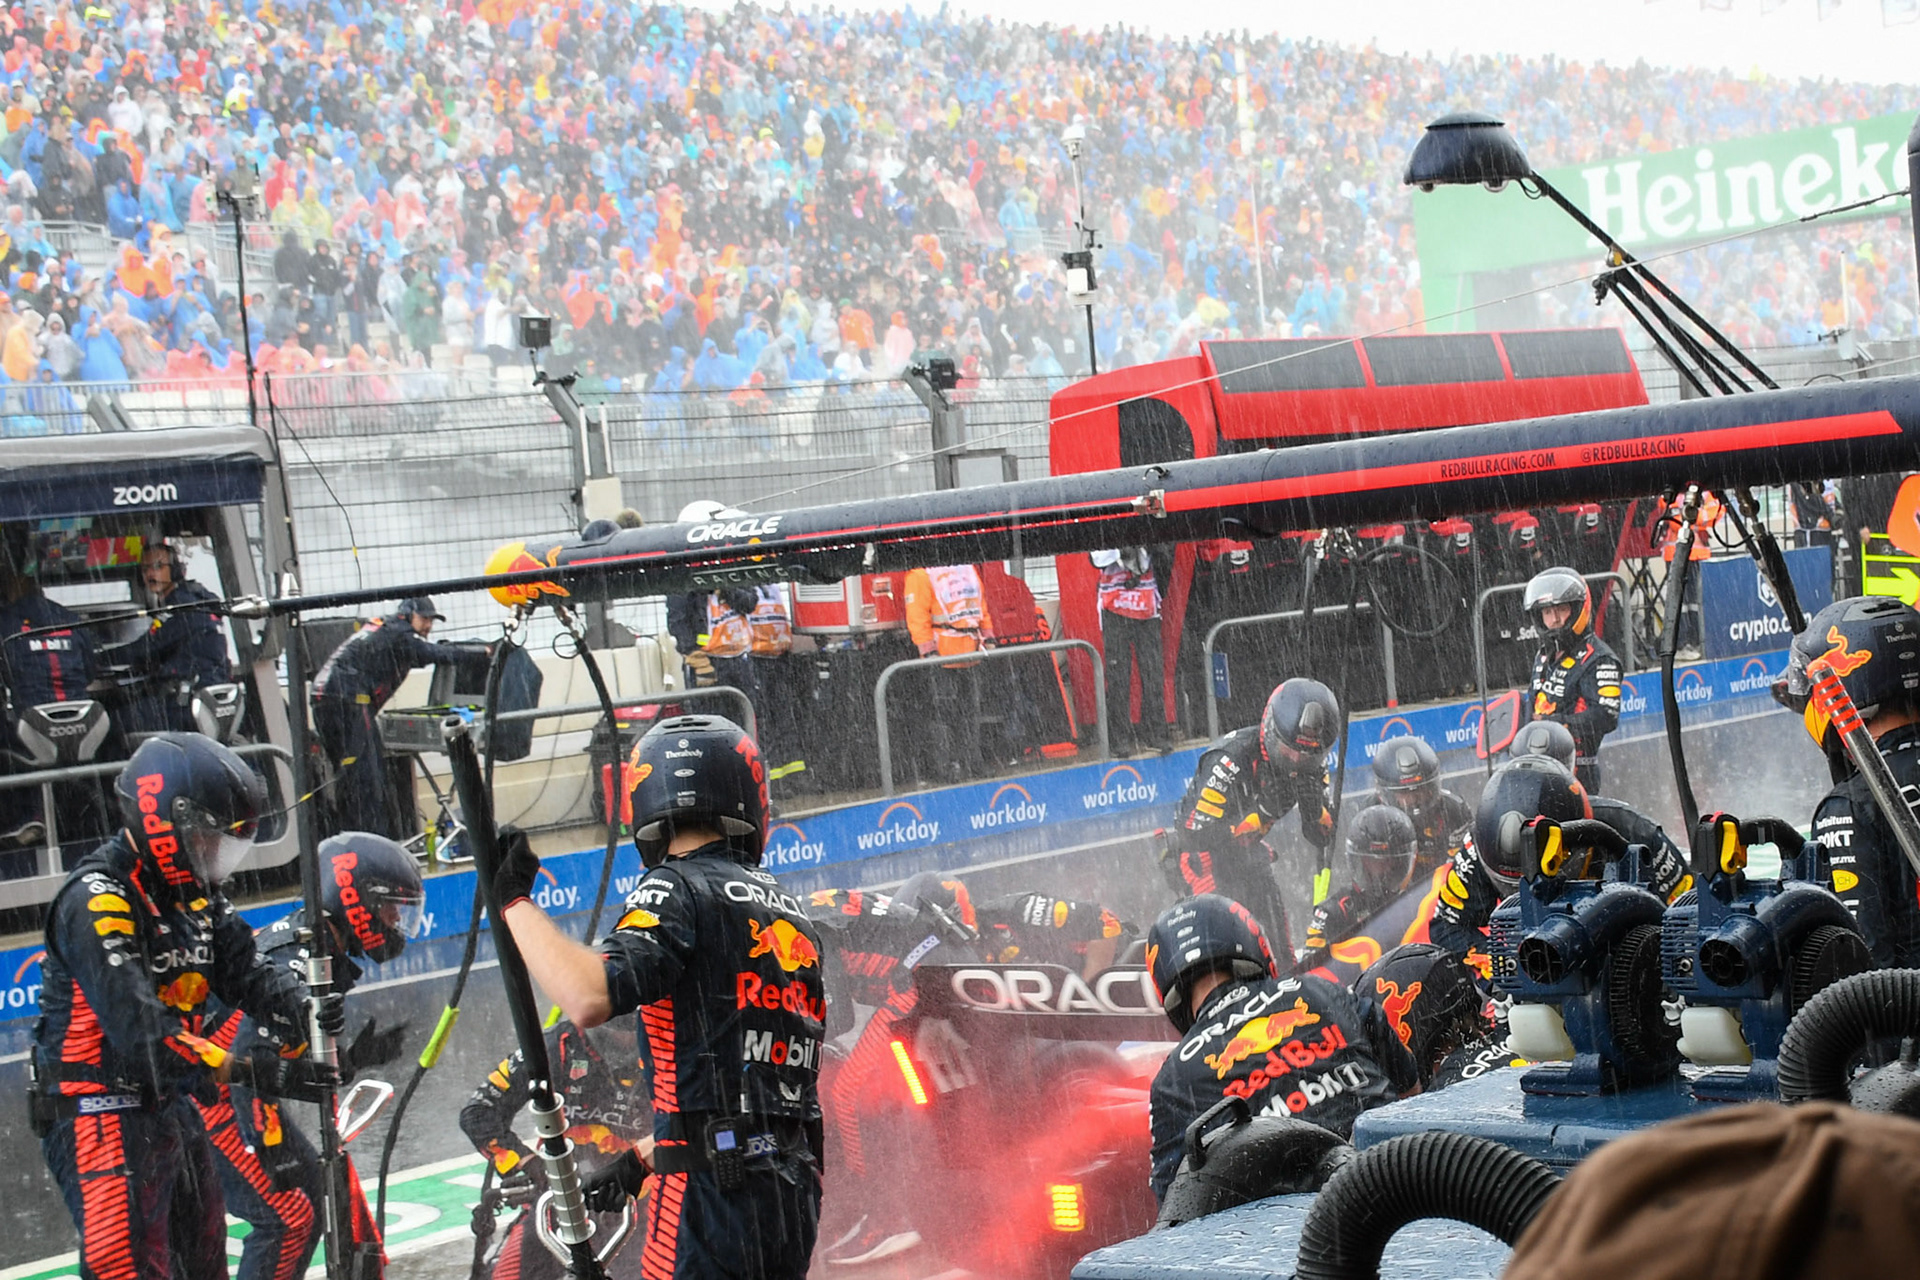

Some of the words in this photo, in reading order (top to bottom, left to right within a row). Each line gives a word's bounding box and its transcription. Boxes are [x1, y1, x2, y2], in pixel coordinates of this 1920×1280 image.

[1582, 127, 1909, 248] Heinek
[1441, 453, 1556, 478] REDBULLRACING.COM
[1581, 438, 1685, 463] @REDBULLRACING
[113, 483, 178, 505] zoom
[686, 516, 783, 543] ORACLE
[693, 567, 789, 585] RACING
[665, 749, 704, 759] Therabody
[626, 890, 670, 906] OKT
[725, 881, 811, 922] ORACL
[951, 969, 1166, 1014] ORACL
[1179, 977, 1302, 1062] ORACLE
[743, 1029, 817, 1069] Mobil
